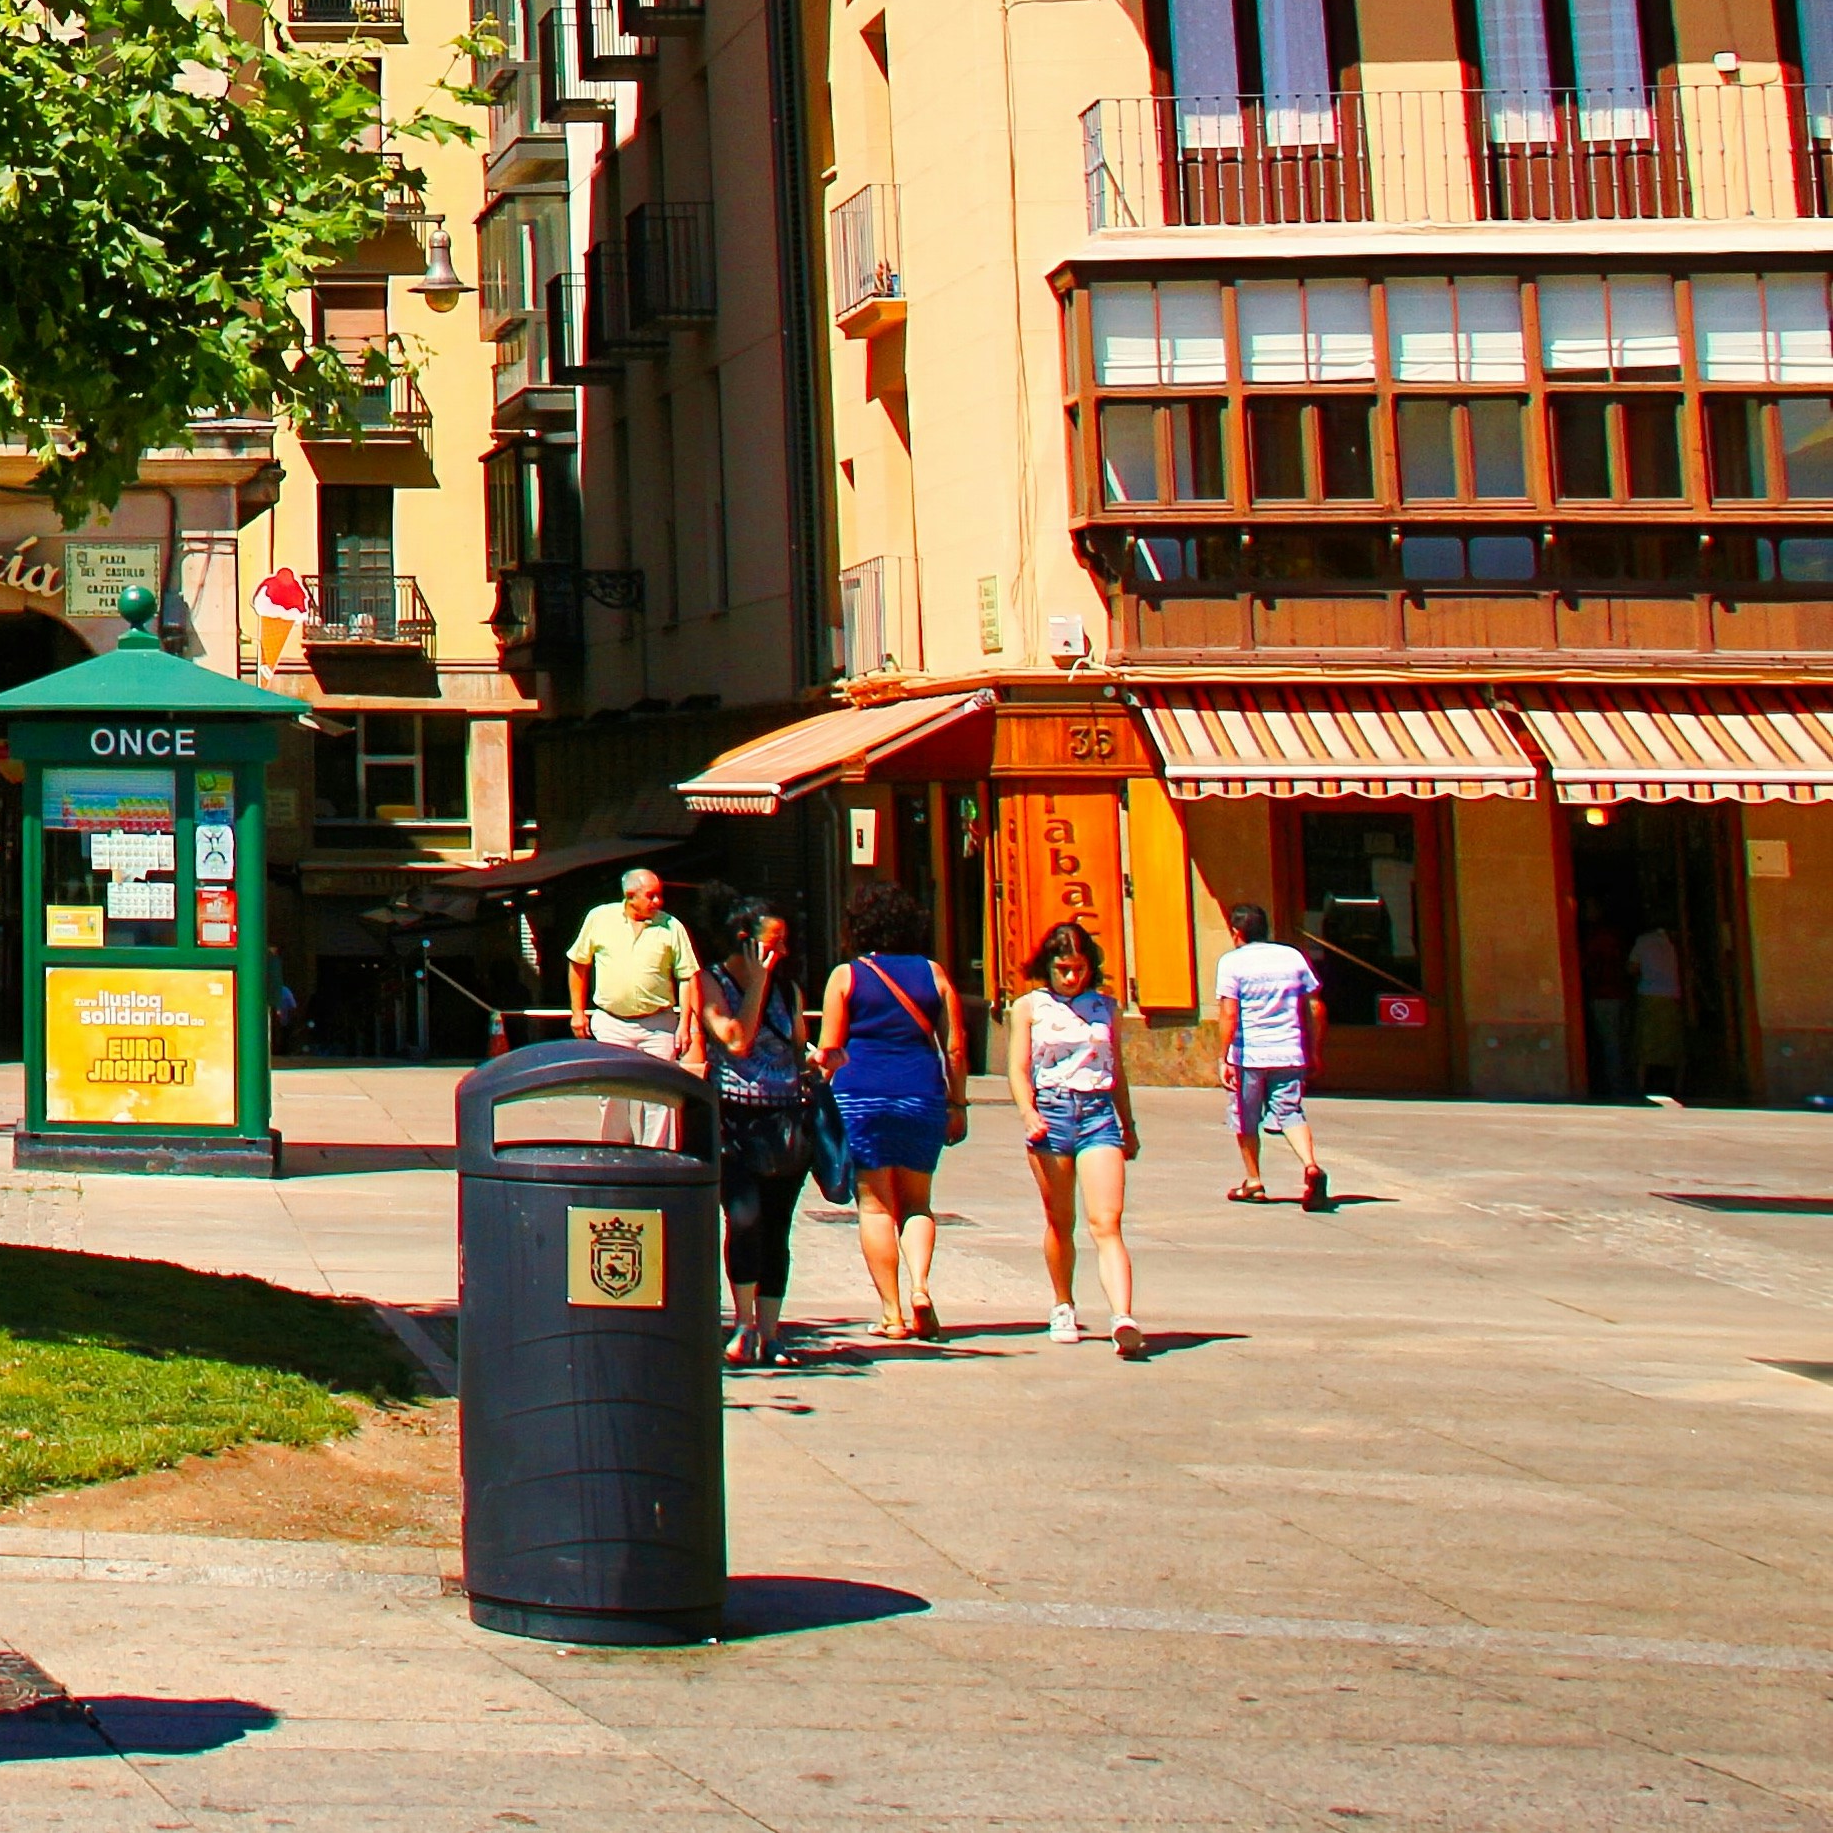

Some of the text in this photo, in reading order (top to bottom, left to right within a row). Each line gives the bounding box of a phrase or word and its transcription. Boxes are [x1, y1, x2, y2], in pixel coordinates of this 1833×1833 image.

[99, 555, 126, 565] PLAZA
[81, 568, 145, 577] DEL CASTILLO
[98, 598, 117, 607] PLA
[90, 728, 196, 756] ONCE
[80, 1006, 190, 1026] solidarioa
[107, 1037, 167, 1060] EURO
[87, 1058, 189, 1085] JACKPOT
